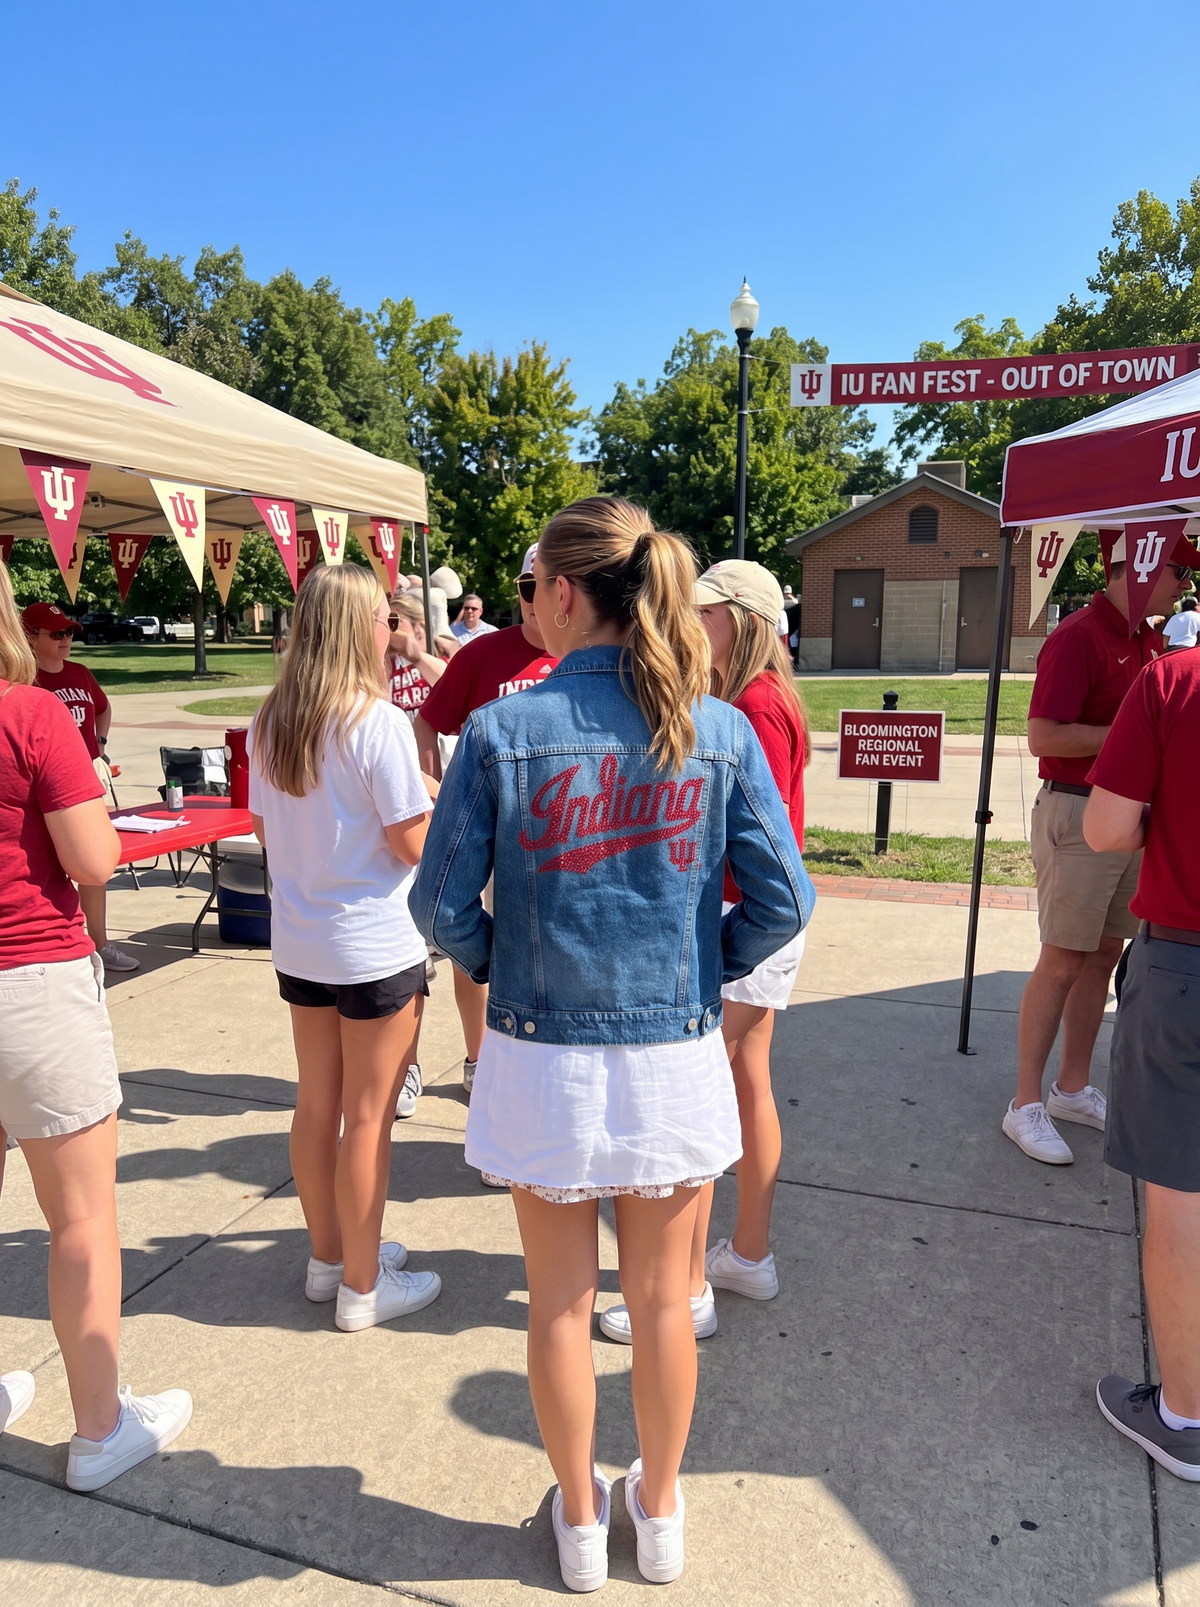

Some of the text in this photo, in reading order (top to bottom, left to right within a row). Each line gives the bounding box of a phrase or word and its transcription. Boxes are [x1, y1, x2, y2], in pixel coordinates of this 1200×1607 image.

[800, 370, 823, 400] IU
[841, 373, 865, 396] IU
[871, 371, 916, 395] FAN
[922, 369, 981, 394] FEST
[1001, 365, 1053, 391] OUT
[1058, 362, 1093, 388] OF
[1098, 355, 1176, 384] TOWN
[41, 466, 75, 521] IU
[169, 491, 199, 538] IU
[266, 504, 292, 546] IU
[118, 538, 139, 568] IU
[211, 538, 232, 570] IU
[323, 517, 340, 556] IU
[378, 522, 395, 559] IU
[1036, 531, 1065, 578] IU
[1133, 531, 1167, 583] IU
[844, 724, 938, 738] BLOOMINGTON
[858, 739, 922, 752] REGIONAL
[855, 753, 924, 767] FAN EVENT
[518, 754, 705, 852] Indiana
